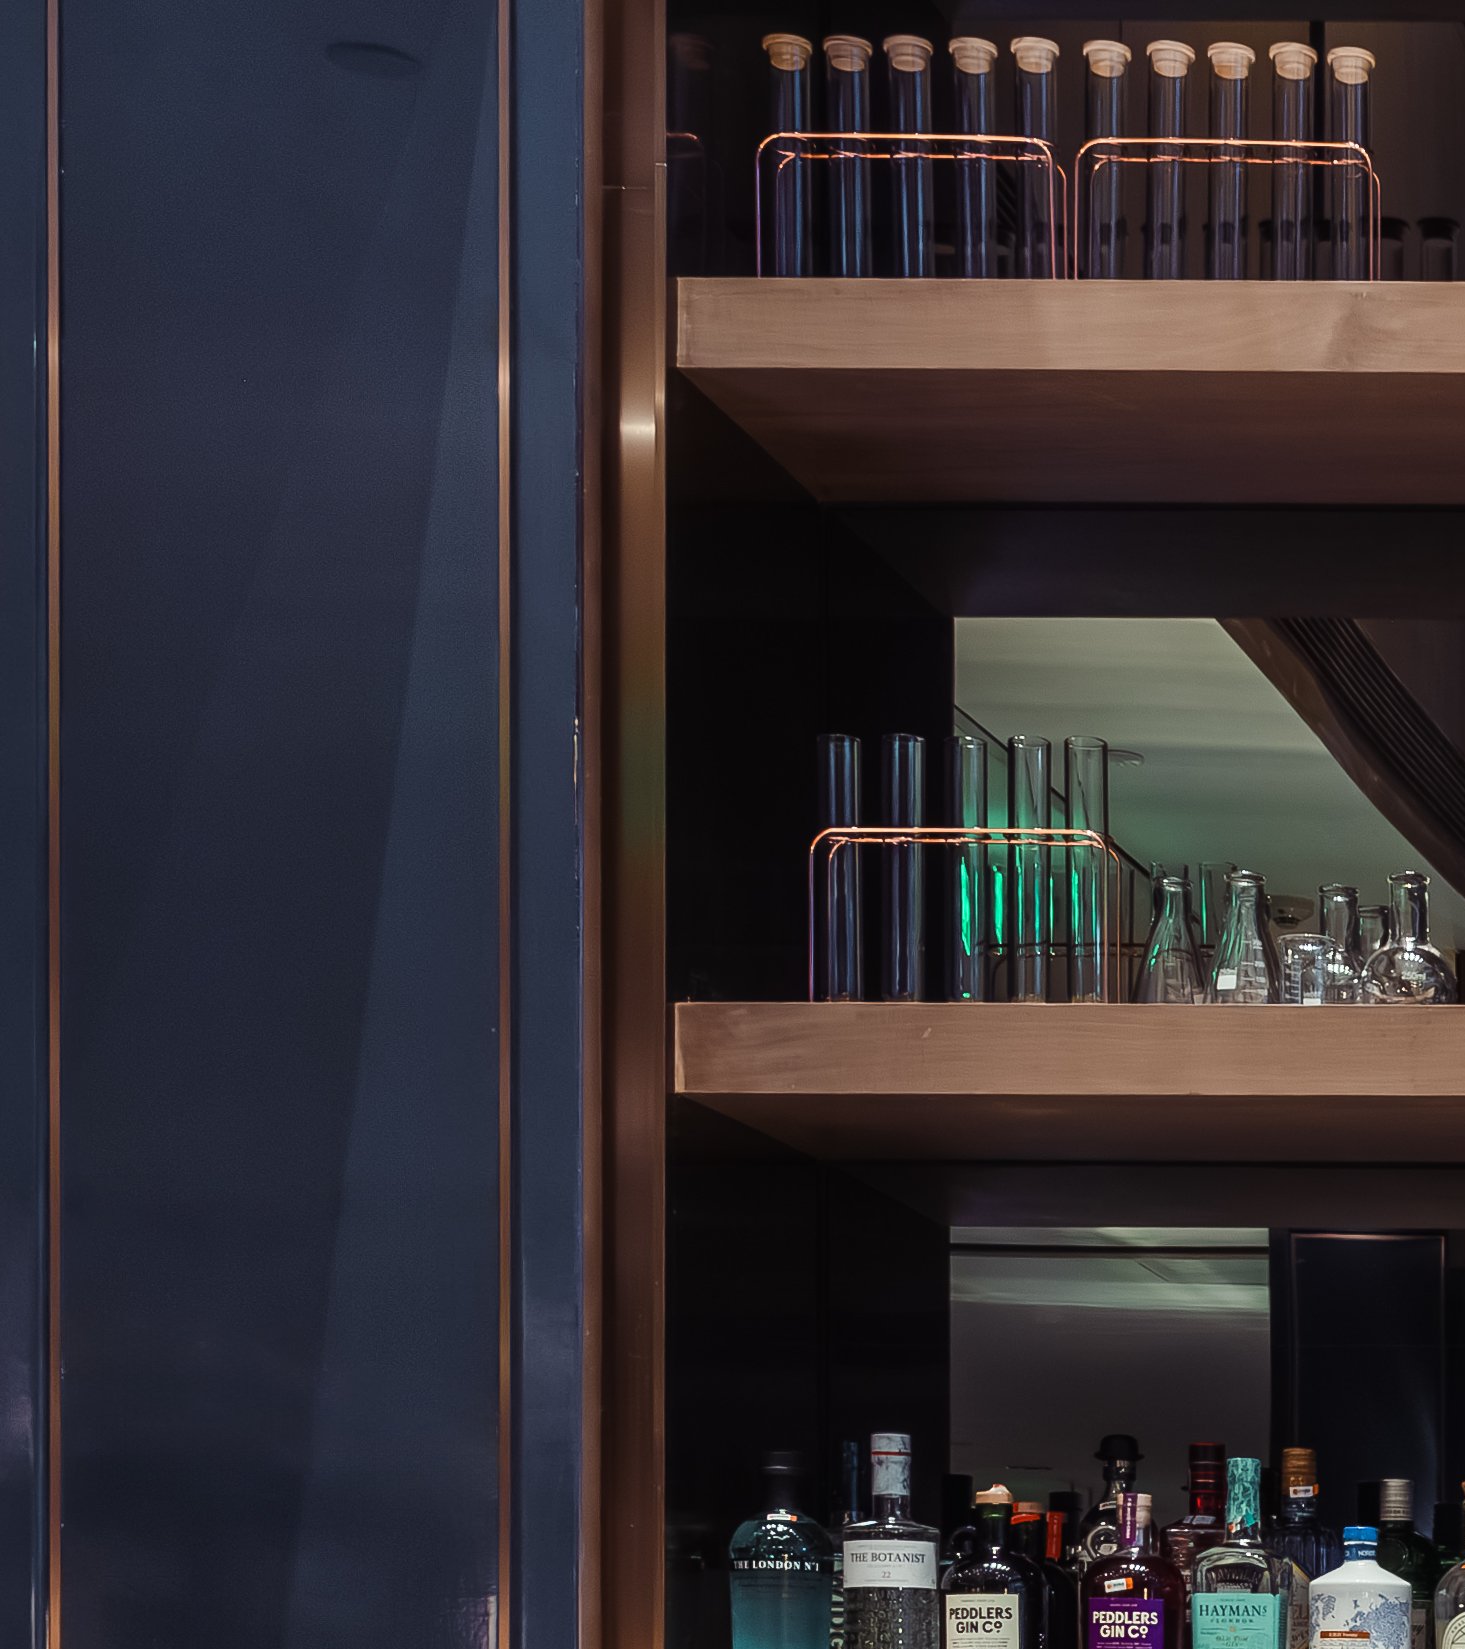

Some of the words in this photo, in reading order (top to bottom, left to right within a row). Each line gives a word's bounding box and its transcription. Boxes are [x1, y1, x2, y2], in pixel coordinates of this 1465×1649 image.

[850, 1553, 868, 1563] THE
[871, 1552, 926, 1564] BOTANIST
[734, 1559, 749, 1569] THE
[752, 1560, 800, 1570] LONDON
[949, 1607, 1013, 1620] PEDDLERS
[1092, 1611, 1158, 1625] PEDDLERS
[956, 1621, 979, 1633] GIN
[1100, 1625, 1125, 1638] GIN
